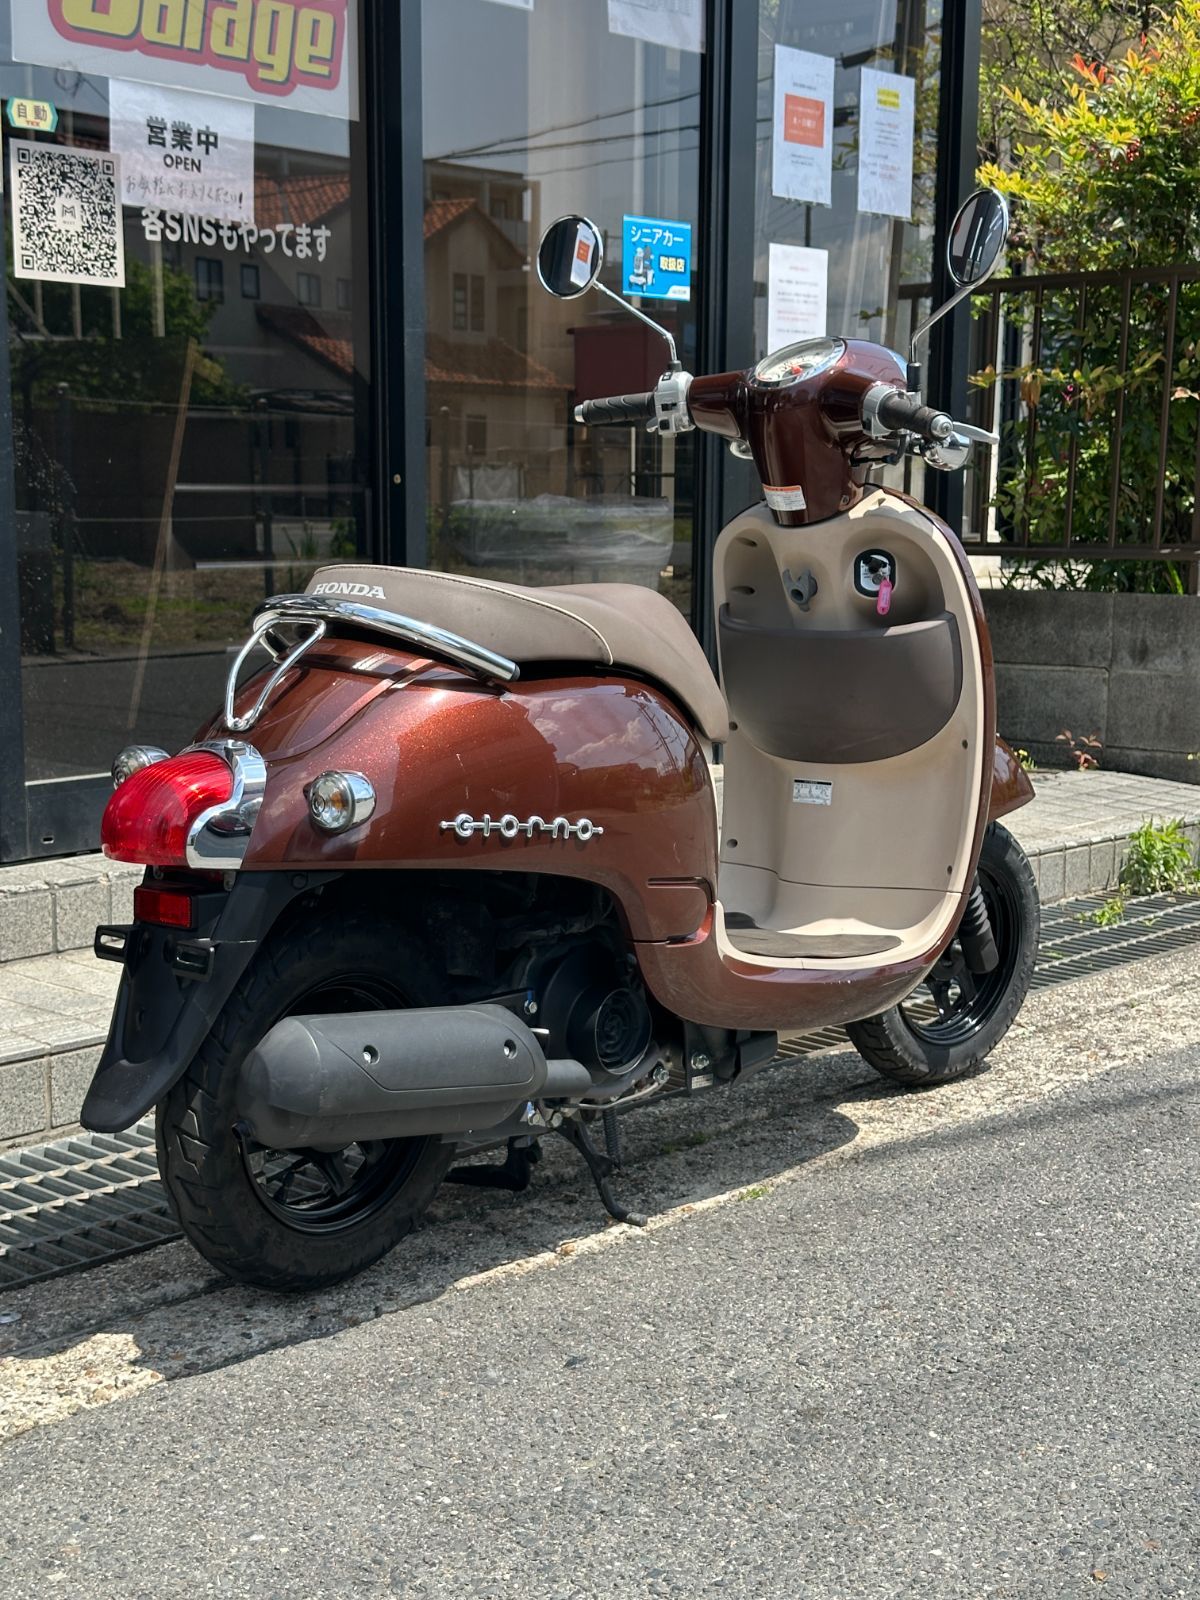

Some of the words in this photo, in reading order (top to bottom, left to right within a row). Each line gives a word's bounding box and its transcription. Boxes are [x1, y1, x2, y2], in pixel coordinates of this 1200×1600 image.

[17, 103, 48, 121] 自動
[146, 115, 219, 155] 営業中
[162, 153, 202, 173] OPEN
[141, 205, 332, 262] 各SNSもやってます
[630, 225, 685, 247] シニアカー
[312, 582, 387, 600] HONDA
